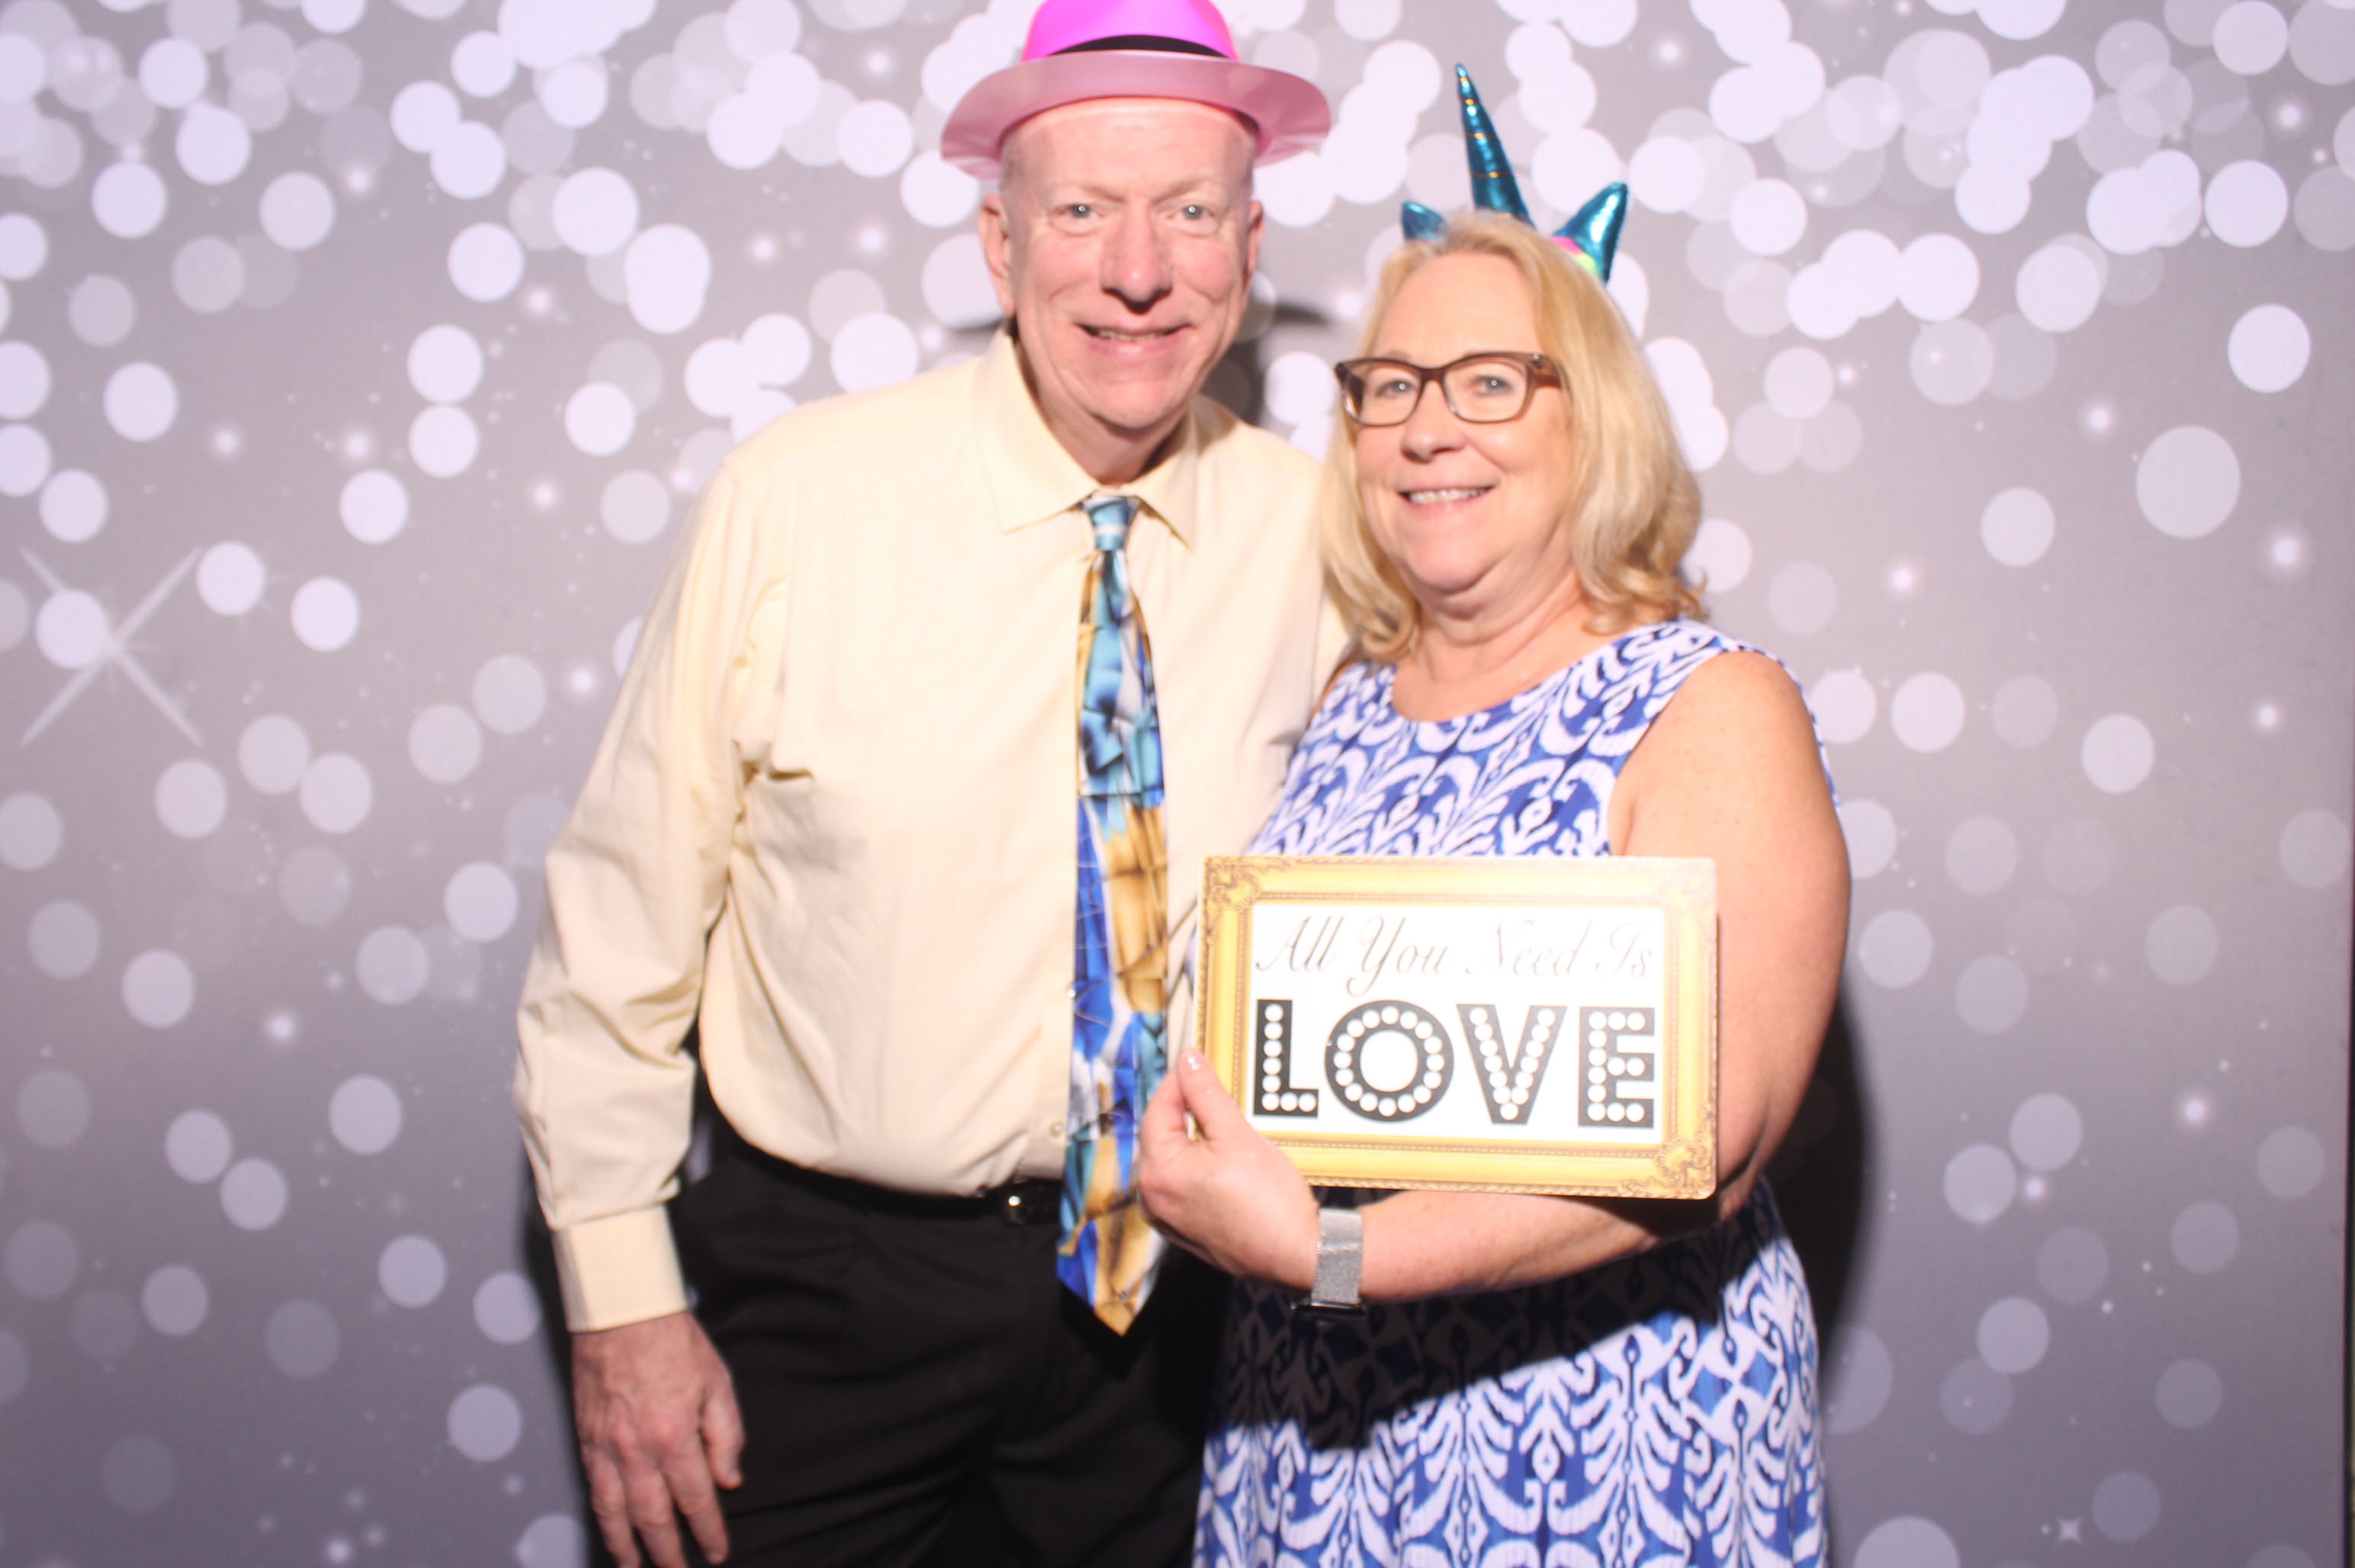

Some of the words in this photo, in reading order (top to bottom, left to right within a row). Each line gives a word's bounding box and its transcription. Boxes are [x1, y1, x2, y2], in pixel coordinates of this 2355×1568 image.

[1256, 916, 1343, 973] All
[1347, 915, 1451, 997] You
[1465, 918, 1593, 977] Need
[1595, 921, 1653, 978] Is
[1253, 999, 1654, 1128] LOVE
